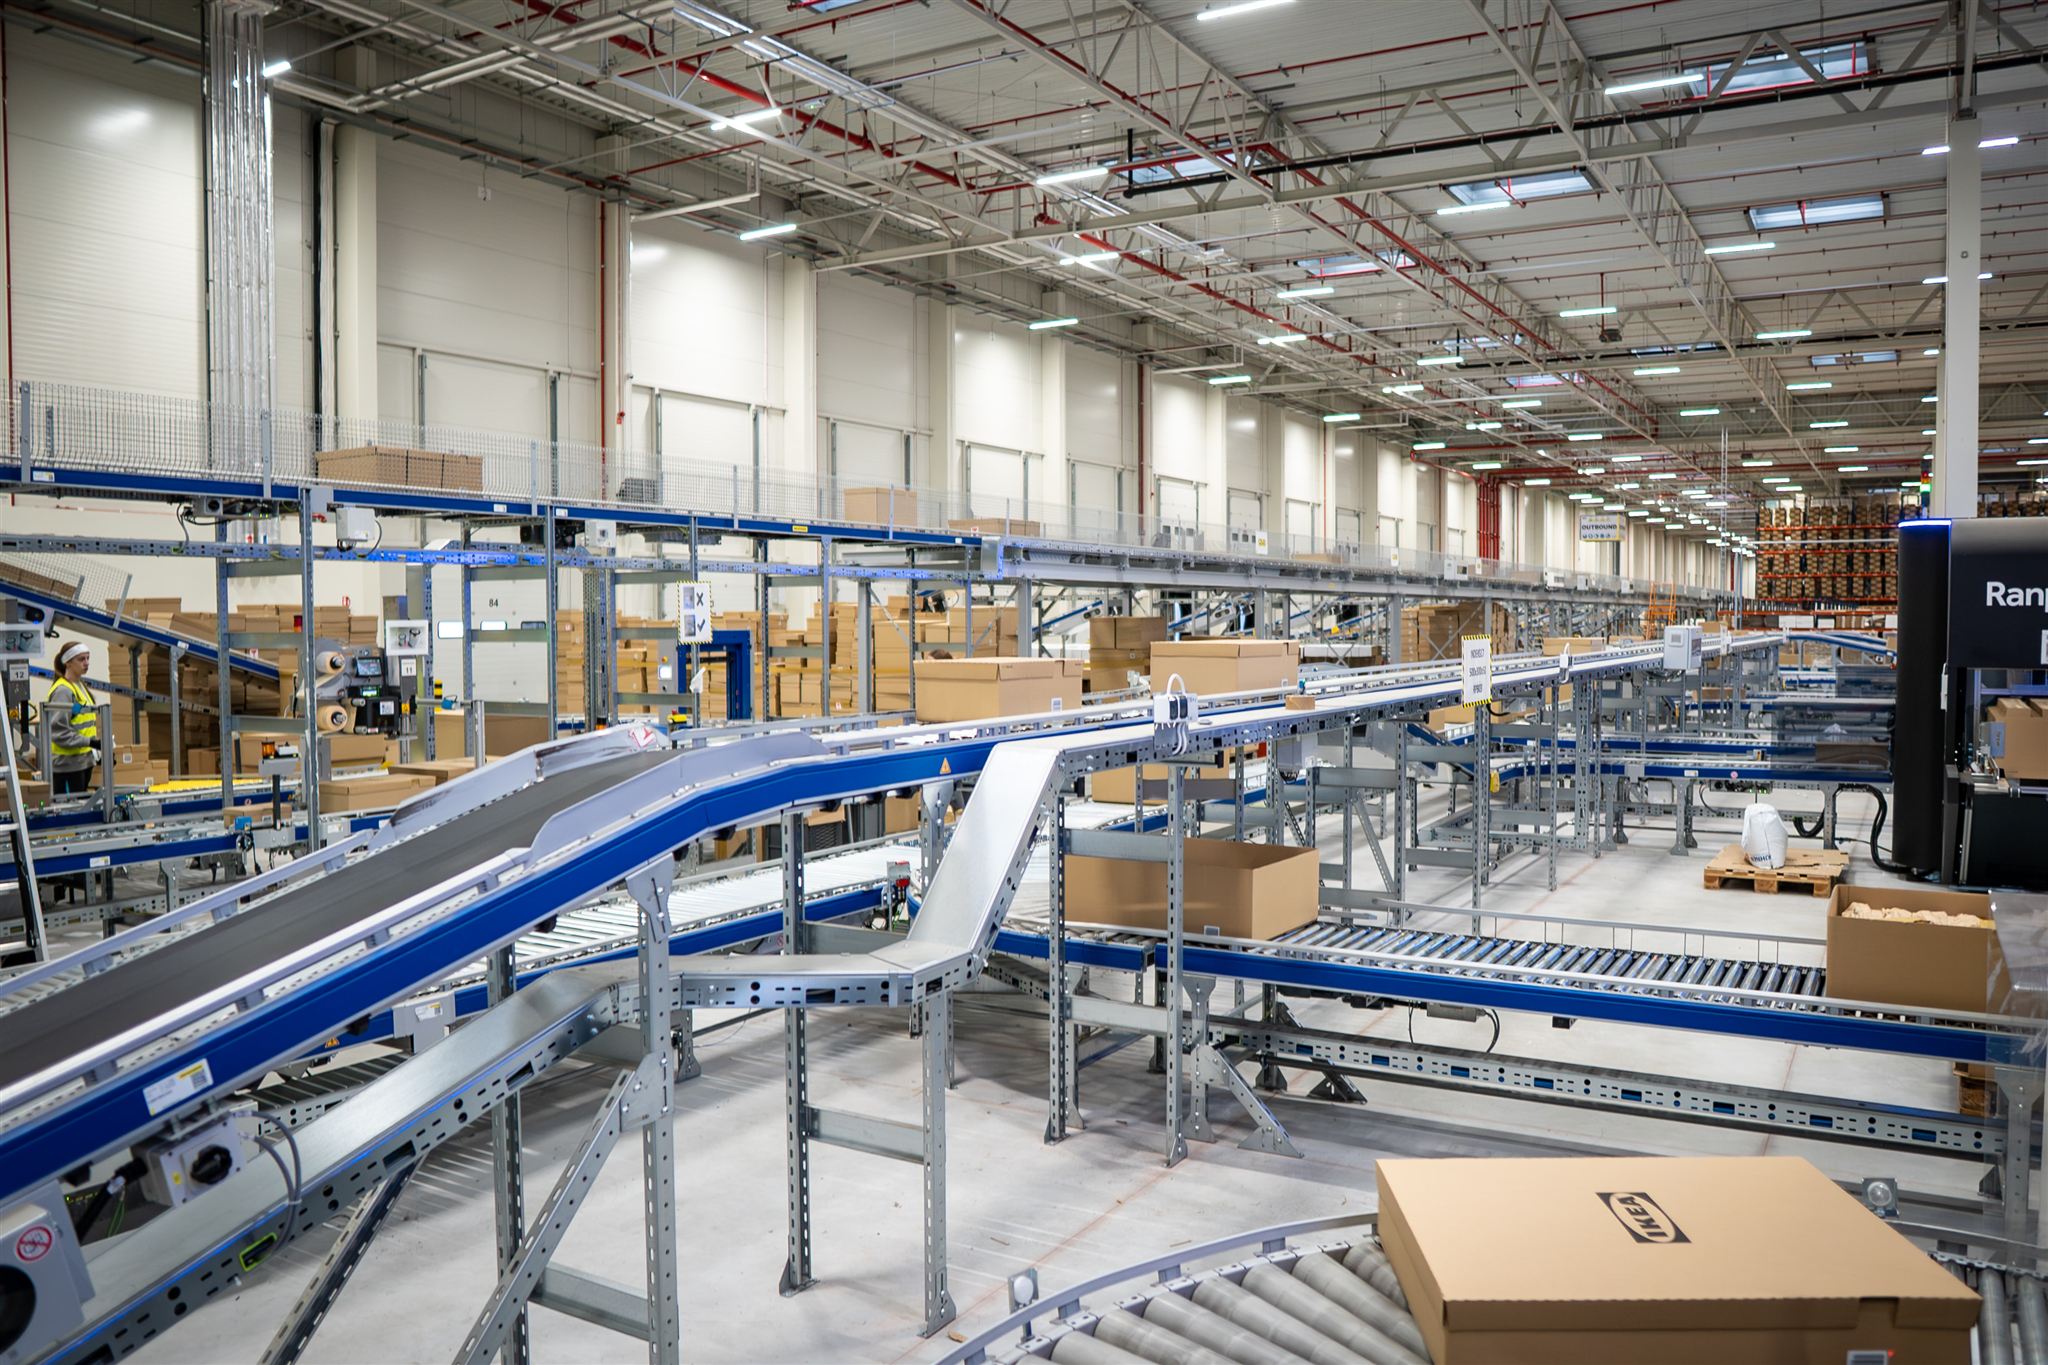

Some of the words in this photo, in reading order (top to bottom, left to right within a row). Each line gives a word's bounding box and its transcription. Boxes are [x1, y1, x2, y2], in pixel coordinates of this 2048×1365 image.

[488, 598, 499, 608] 84
[1986, 581, 2048, 613] Ran
[15, 671, 25, 679] 12
[1616, 1196, 1669, 1238] IKEA
